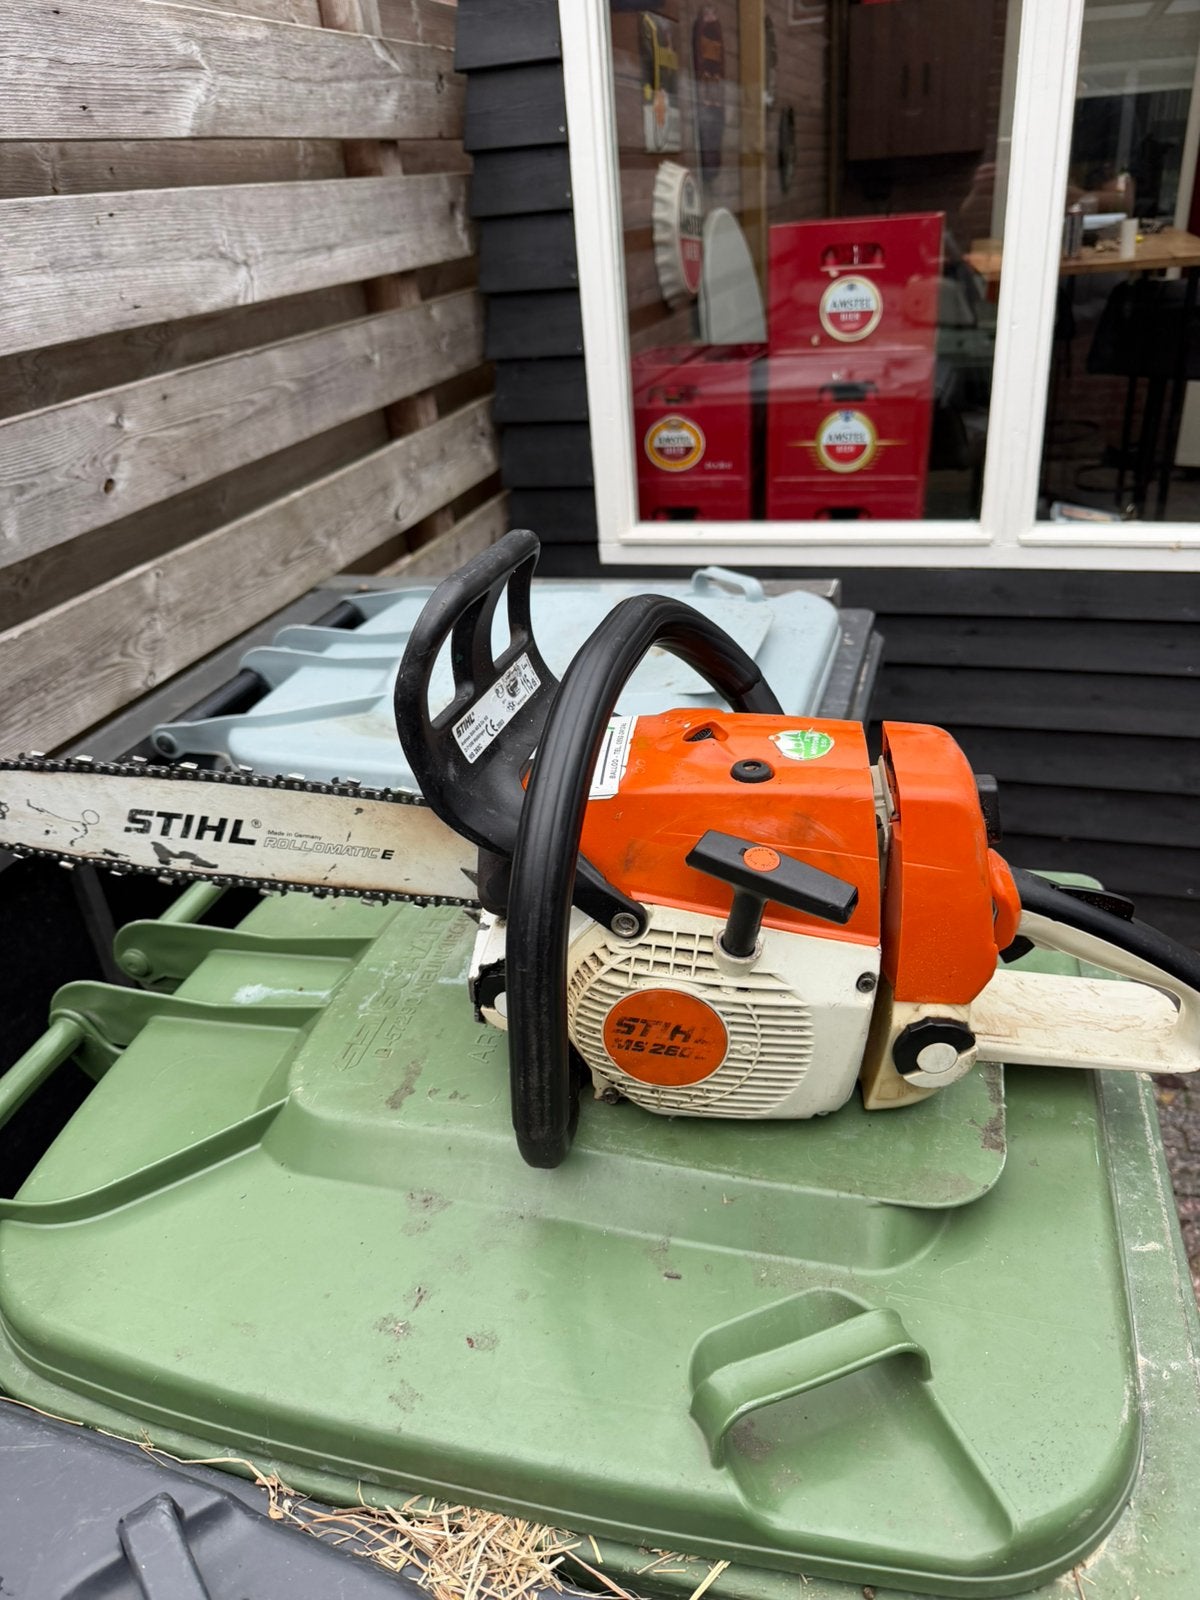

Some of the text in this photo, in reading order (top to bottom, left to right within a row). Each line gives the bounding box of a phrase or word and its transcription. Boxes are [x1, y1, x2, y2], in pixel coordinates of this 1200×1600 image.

[832, 296, 872, 309] AMSTEL
[828, 432, 865, 443] AMSTEL
[455, 715, 475, 738] STIHL
[124, 808, 256, 846] STIHL
[267, 829, 285, 837] Made
[294, 831, 322, 840] Germany
[263, 836, 395, 860] ROLLOMATIC E
